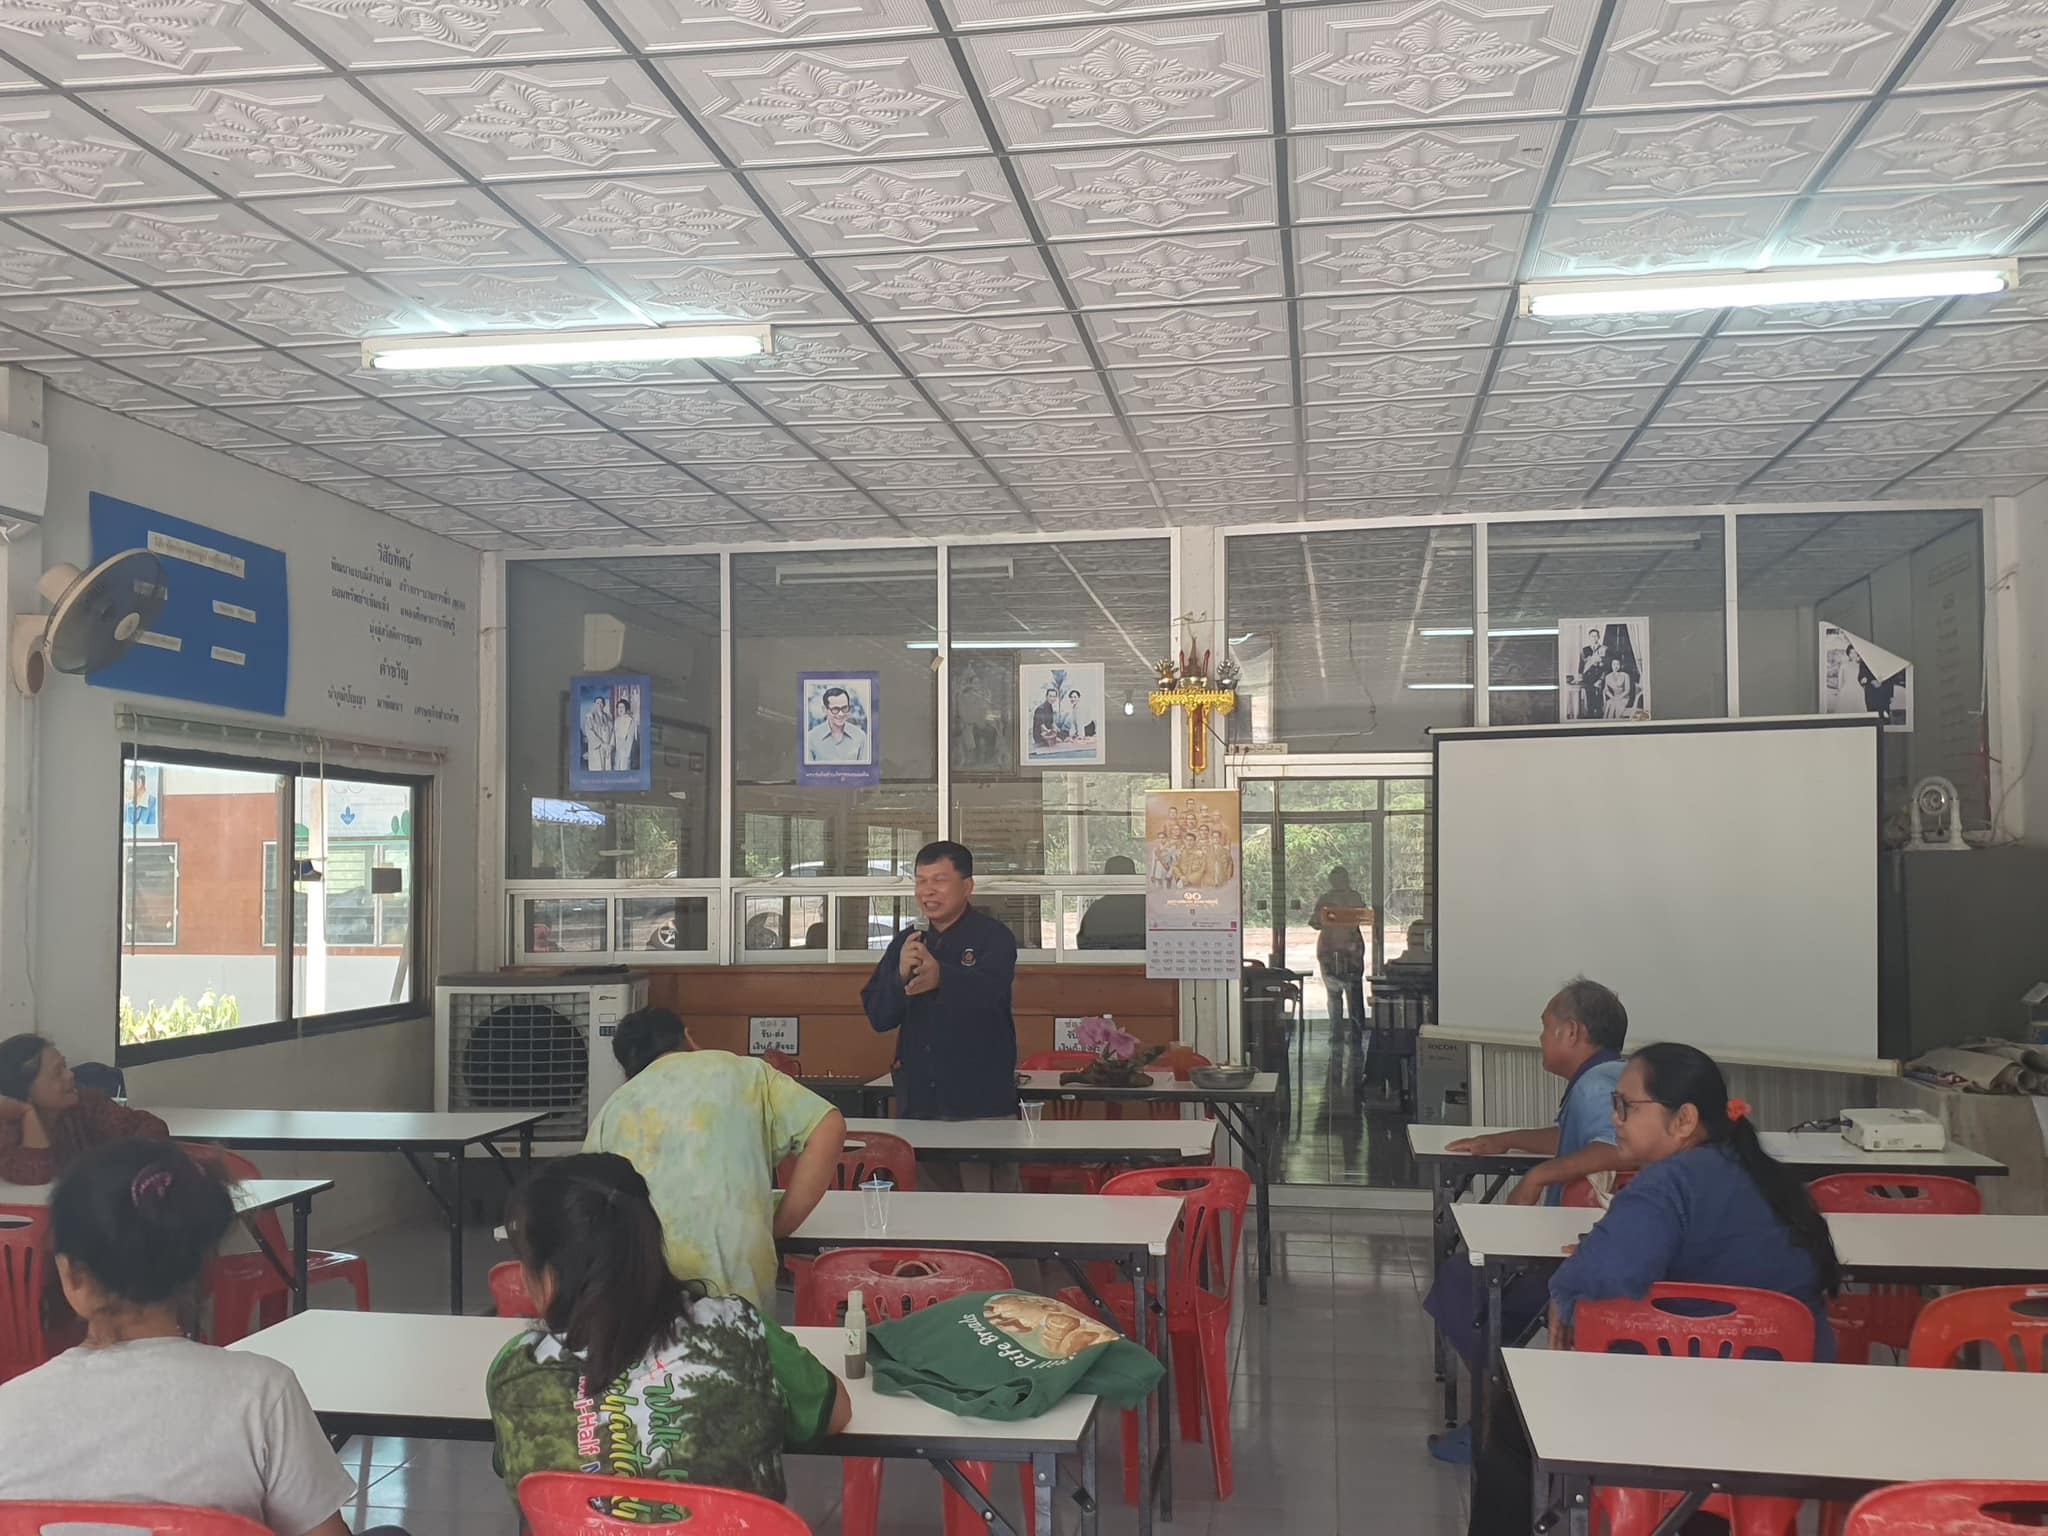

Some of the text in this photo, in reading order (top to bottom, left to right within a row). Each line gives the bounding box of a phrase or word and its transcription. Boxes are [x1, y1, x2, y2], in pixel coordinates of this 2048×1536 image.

[377, 543, 414, 570] วิสัยทัศน์
[379, 657, 409, 686] คำขวัญ
[958, 1313, 999, 1346] Breads
[997, 1341, 1036, 1368] Life
